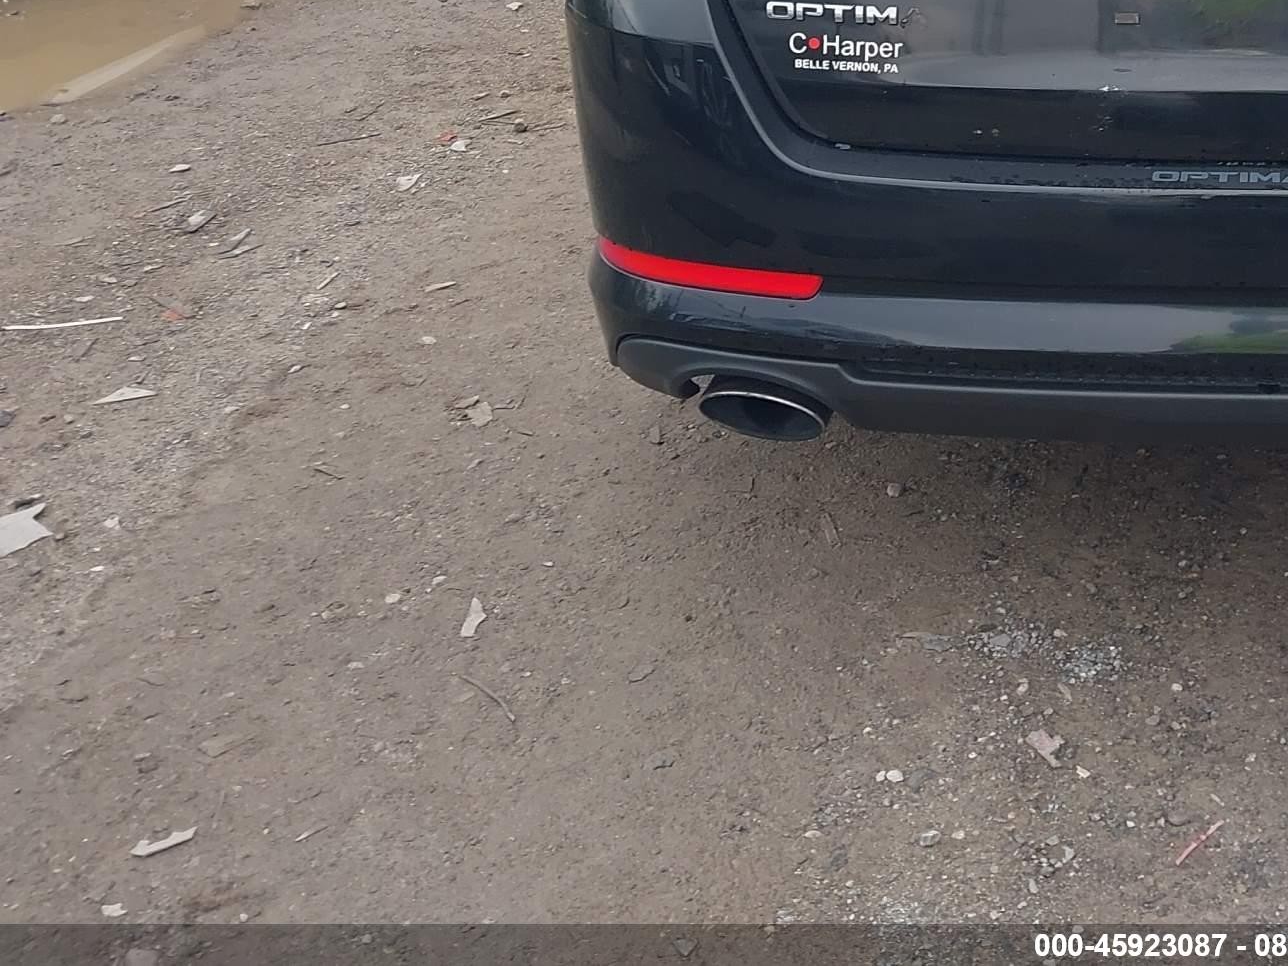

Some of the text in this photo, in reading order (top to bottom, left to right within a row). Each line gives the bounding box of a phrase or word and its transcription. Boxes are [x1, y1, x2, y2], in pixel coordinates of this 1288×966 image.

[794, 58, 899, 74] BELLE VERNON, PA
